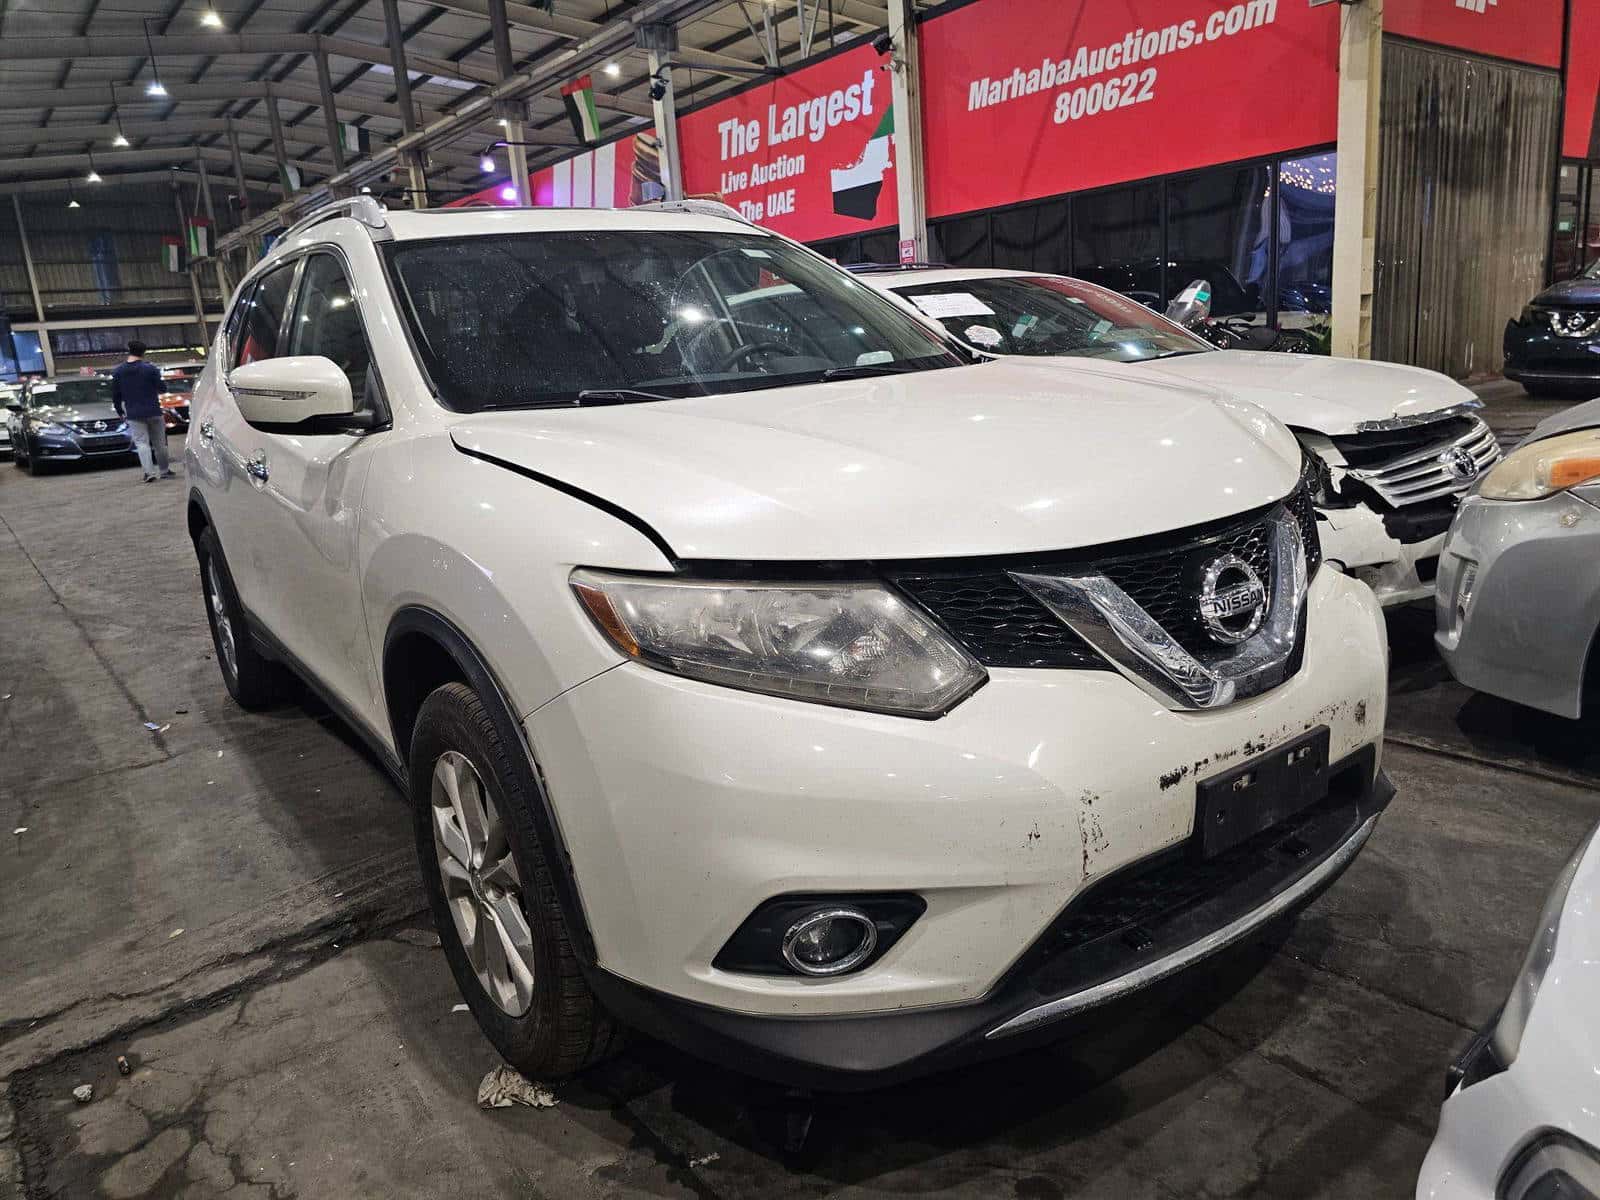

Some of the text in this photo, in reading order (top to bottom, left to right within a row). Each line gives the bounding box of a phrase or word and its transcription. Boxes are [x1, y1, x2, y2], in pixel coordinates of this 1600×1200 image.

[968, 0, 1277, 111] MarhabaAuctions.com
[718, 70, 874, 160] The Largest
[1054, 68, 1157, 124] 800622
[721, 155, 805, 194] Live Auction
[739, 189, 795, 222] The UAE
[1213, 587, 1264, 614] NISSAN
